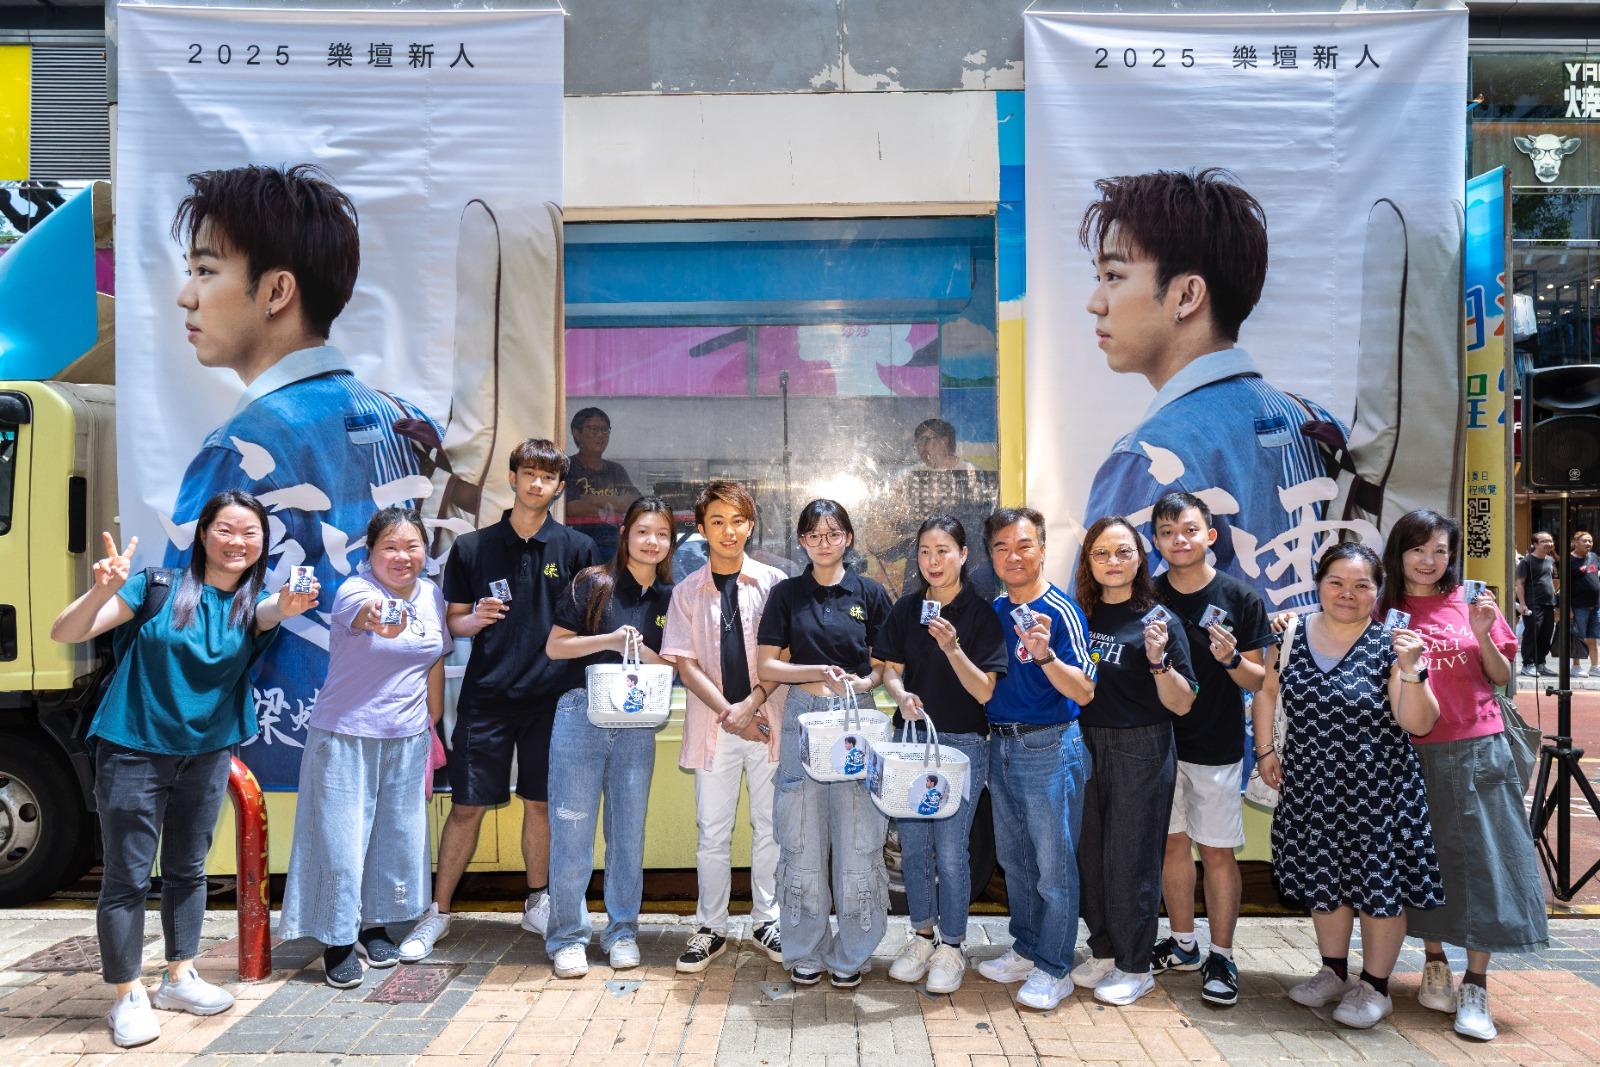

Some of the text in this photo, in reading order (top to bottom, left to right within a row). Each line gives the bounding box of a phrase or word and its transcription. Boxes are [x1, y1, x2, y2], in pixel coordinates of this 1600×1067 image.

[187, 42, 476, 69] 2025 樂壇新人
[1094, 44, 1381, 70] 2025 樂壇新人
[1564, 63, 1600, 82] YA
[1412, 623, 1474, 640] REAM
[1420, 638, 1461, 654] SALT
[1419, 651, 1469, 671] OLIVE
